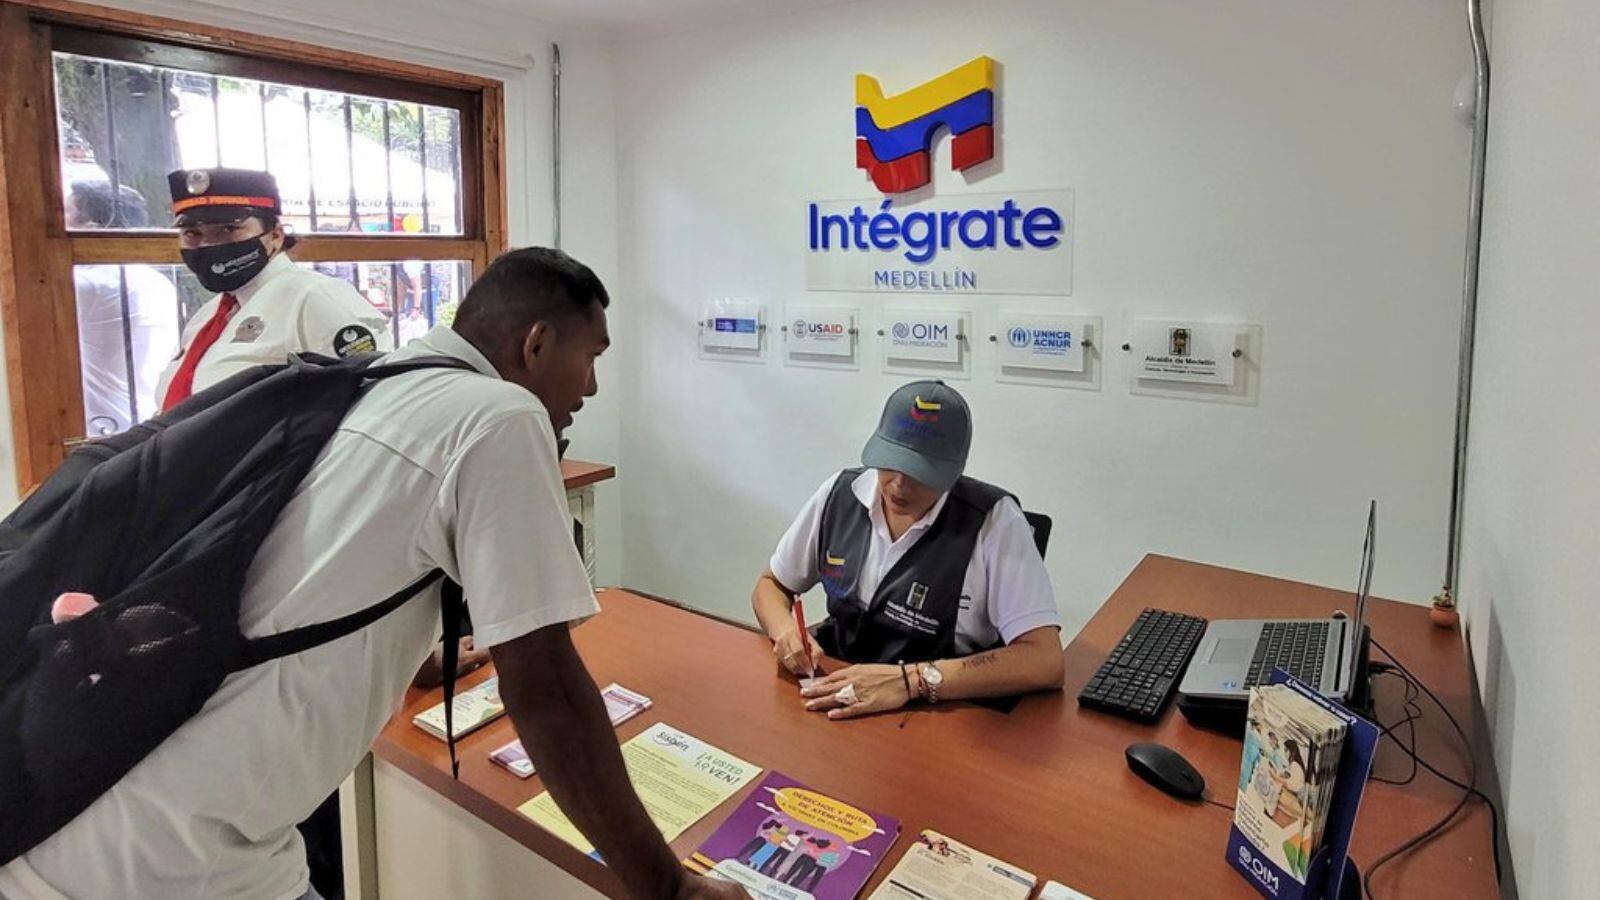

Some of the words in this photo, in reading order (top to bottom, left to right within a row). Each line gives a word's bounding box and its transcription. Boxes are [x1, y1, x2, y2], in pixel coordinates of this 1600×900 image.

[809, 199, 1062, 263] Intégrate
[874, 266, 977, 289] MEDELLÍN
[808, 323, 843, 334] USAID
[912, 323, 948, 341] OIM
[1033, 330, 1071, 340] UNHCR
[1033, 338, 1071, 348] ACNUR
[709, 766, 741, 786] VEN!
[713, 758, 744, 776] USTED
[1252, 858, 1279, 891] OIM
